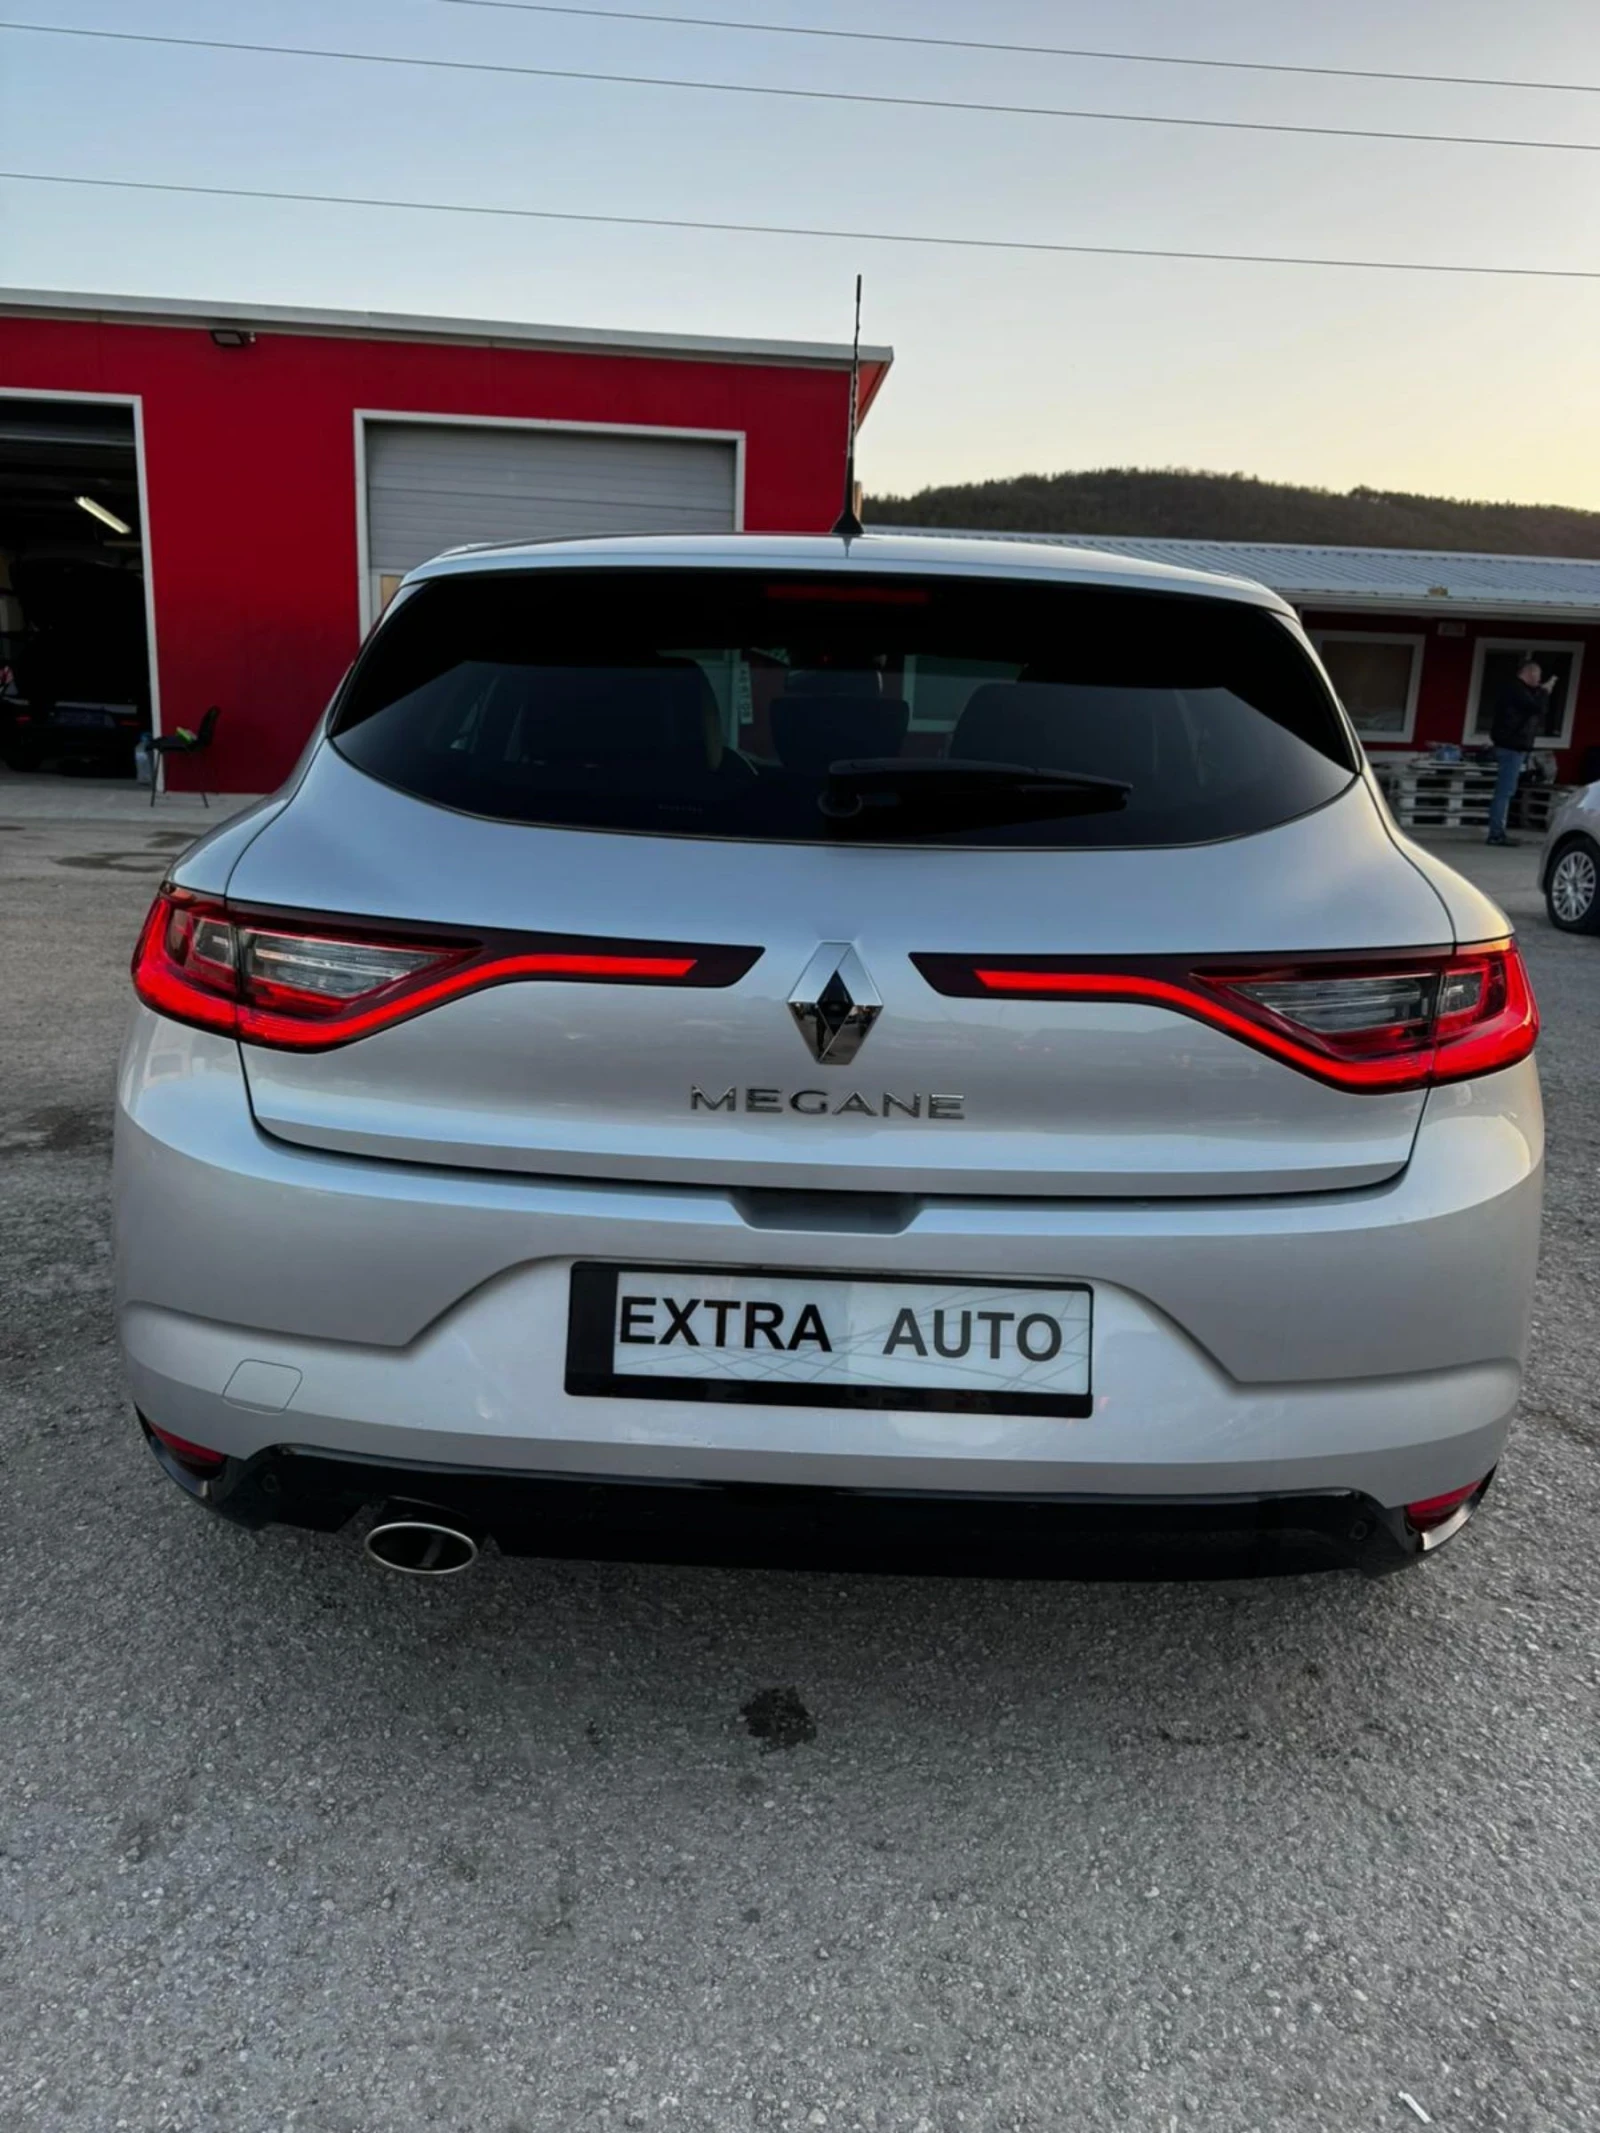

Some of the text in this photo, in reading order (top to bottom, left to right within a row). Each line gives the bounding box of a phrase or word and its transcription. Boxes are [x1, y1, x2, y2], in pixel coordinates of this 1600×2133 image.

[690, 1084, 965, 1120] MEGANE
[619, 1295, 1062, 1362] EXTRA AUTO
